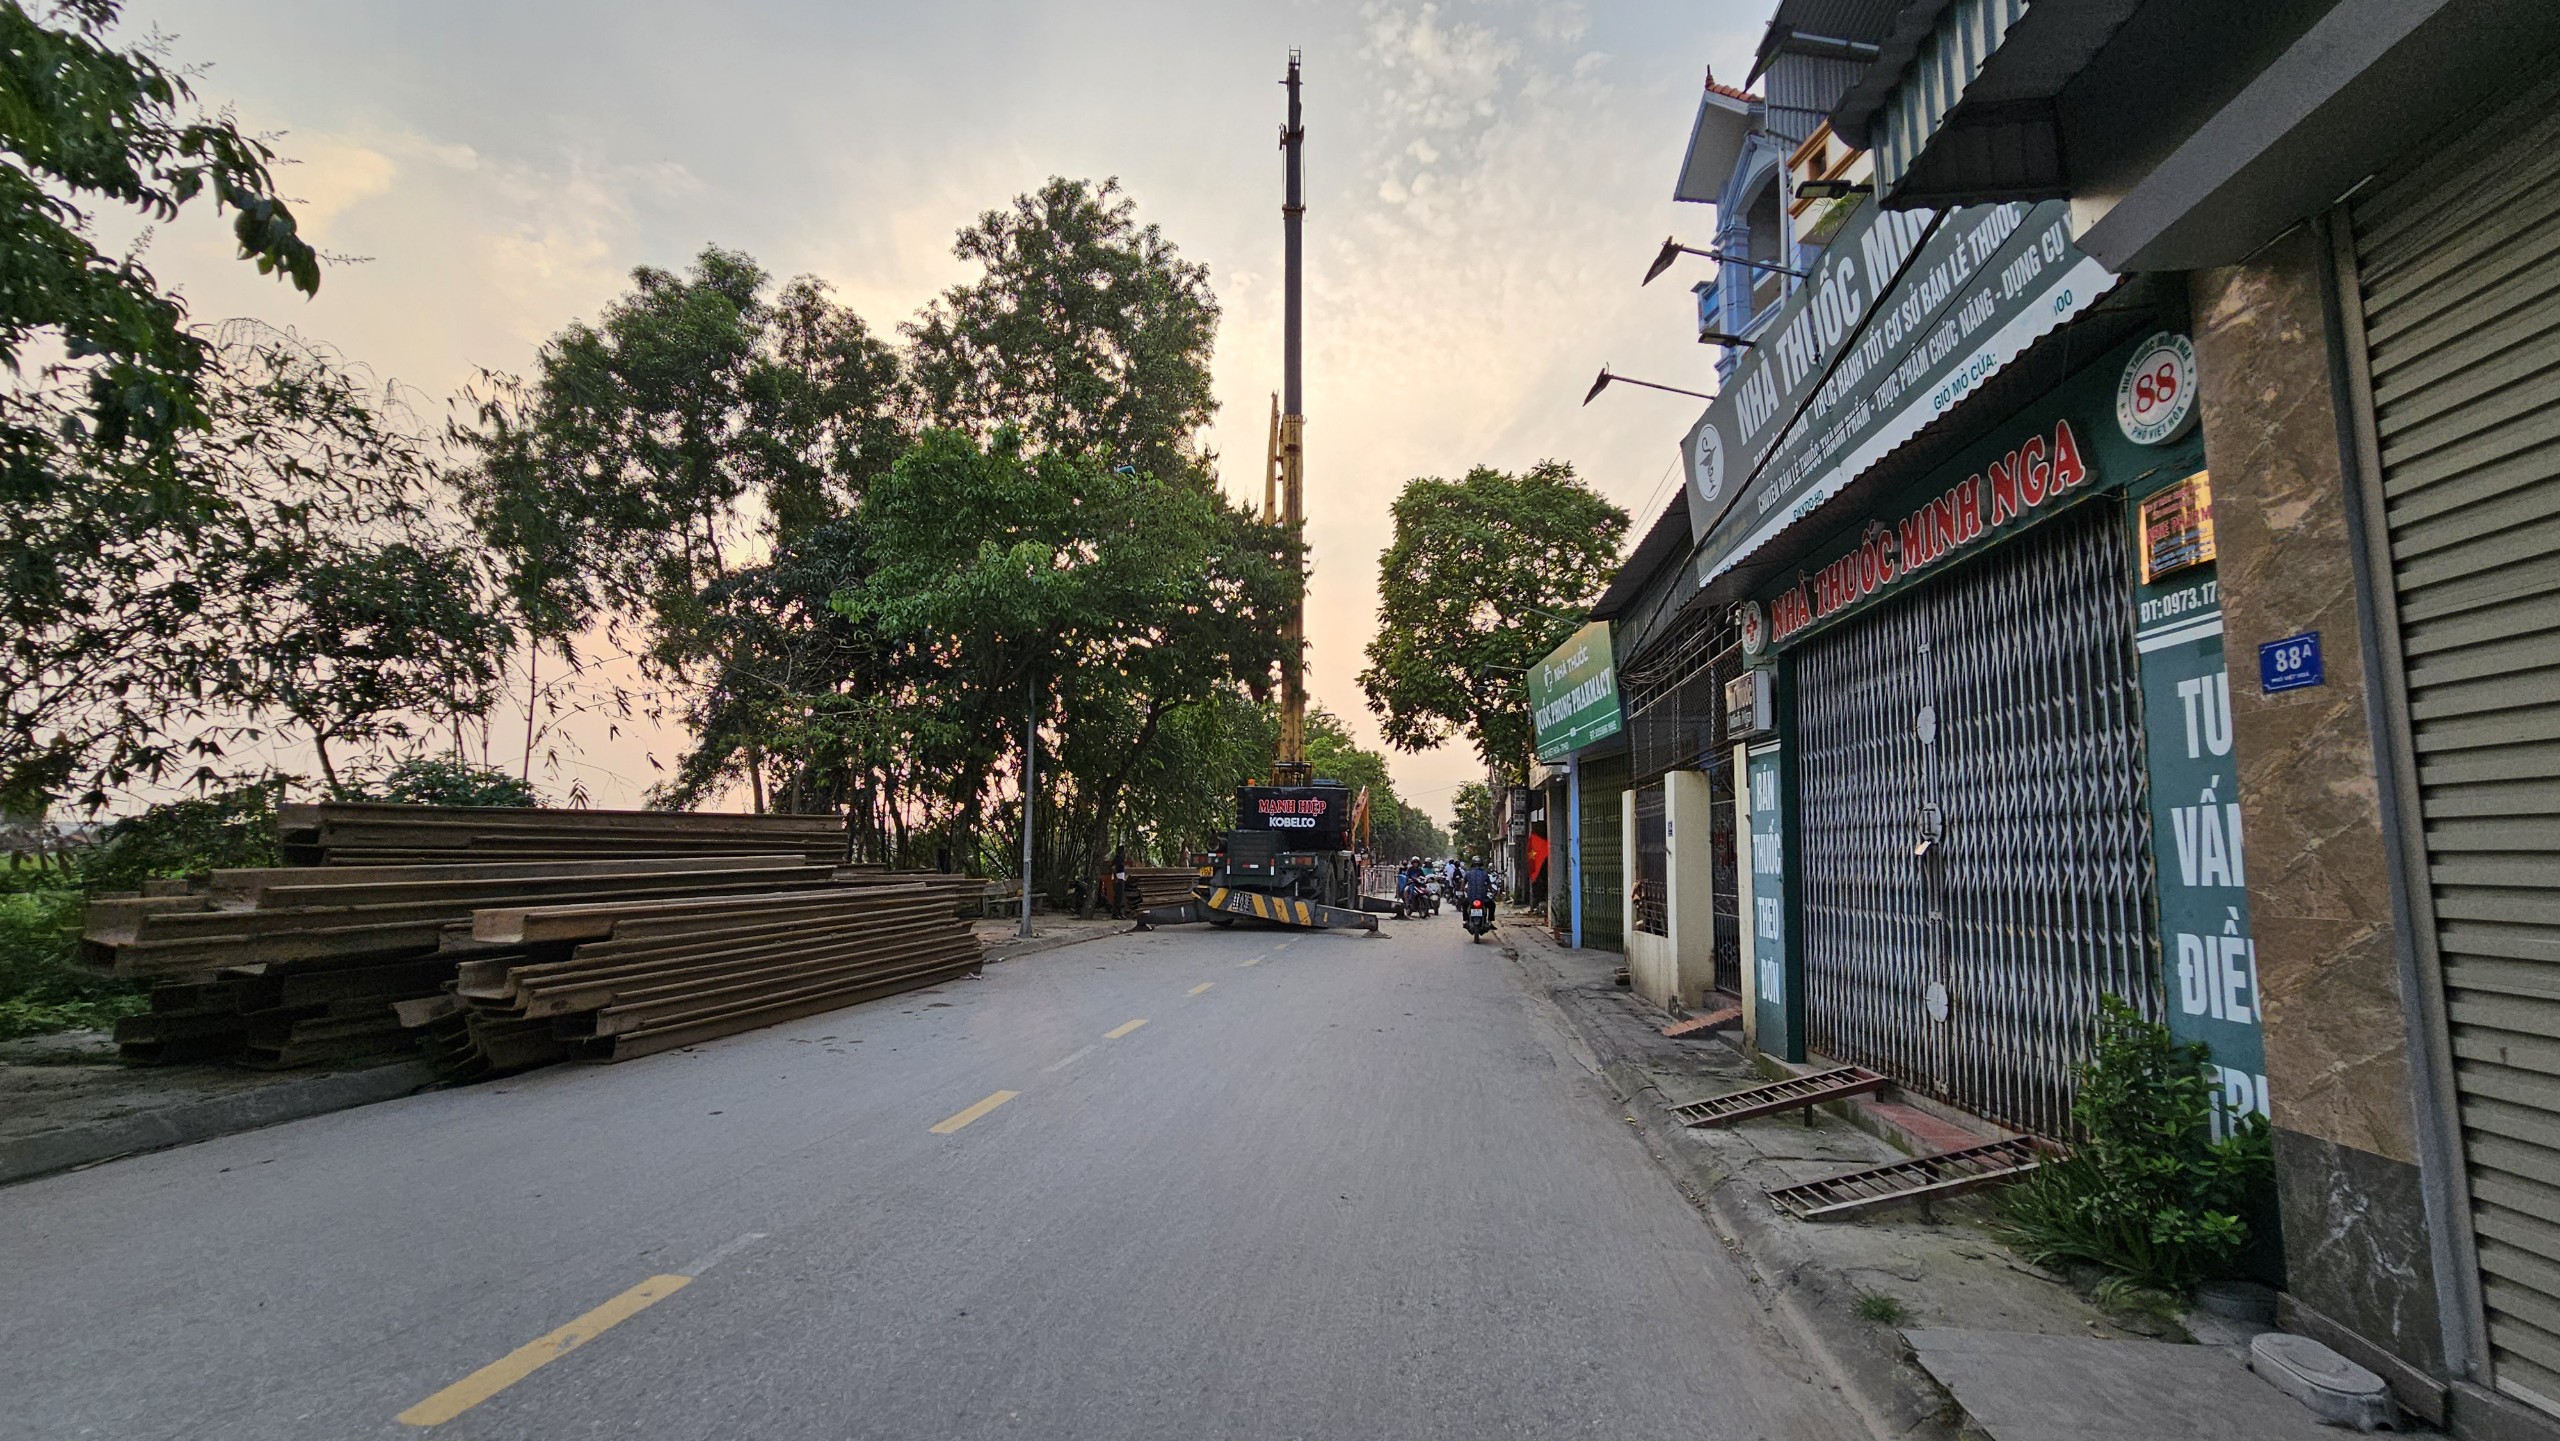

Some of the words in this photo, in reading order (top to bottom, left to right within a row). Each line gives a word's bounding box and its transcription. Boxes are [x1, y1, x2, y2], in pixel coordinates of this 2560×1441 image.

[1836, 349, 1865, 398] HÀNH
[1863, 325, 1885, 370] TỐT
[1884, 308, 1902, 349] CƠ
[1902, 282, 1921, 333] SỞ
[1920, 263, 1951, 315] BÁN
[1949, 233, 1971, 286] LẺ
[1875, 371, 1900, 411] THỰC
[1929, 318, 1960, 365] CHỨC
[1958, 287, 1995, 339] NĂNG
[2001, 244, 2042, 300] DỤNG
[2041, 221, 2065, 263] CỤ
[1735, 349, 1779, 446] NHÀ
[1776, 252, 1861, 396] THUỐC
[2136, 362, 2177, 413] 88
[1771, 570, 1811, 643] NHÀ
[1814, 519, 1894, 618] THUỐC
[1899, 473, 1982, 575] MINH
[1989, 418, 2086, 527] NGA
[2140, 580, 2219, 624] ĐT:0973.17
[2275, 643, 2312, 672] 88A
[1570, 667, 1612, 714] PHARMACY
[1258, 799, 1296, 816] MẠNH
[1298, 797, 1327, 817] HIỆP
[1756, 763, 1775, 812] BÁN
[1269, 817, 1316, 828] KOBELCO
[1753, 819, 1781, 875] THUỐC
[1757, 896, 1780, 941] THEO
[1760, 956, 1780, 1005] ĐƠN
